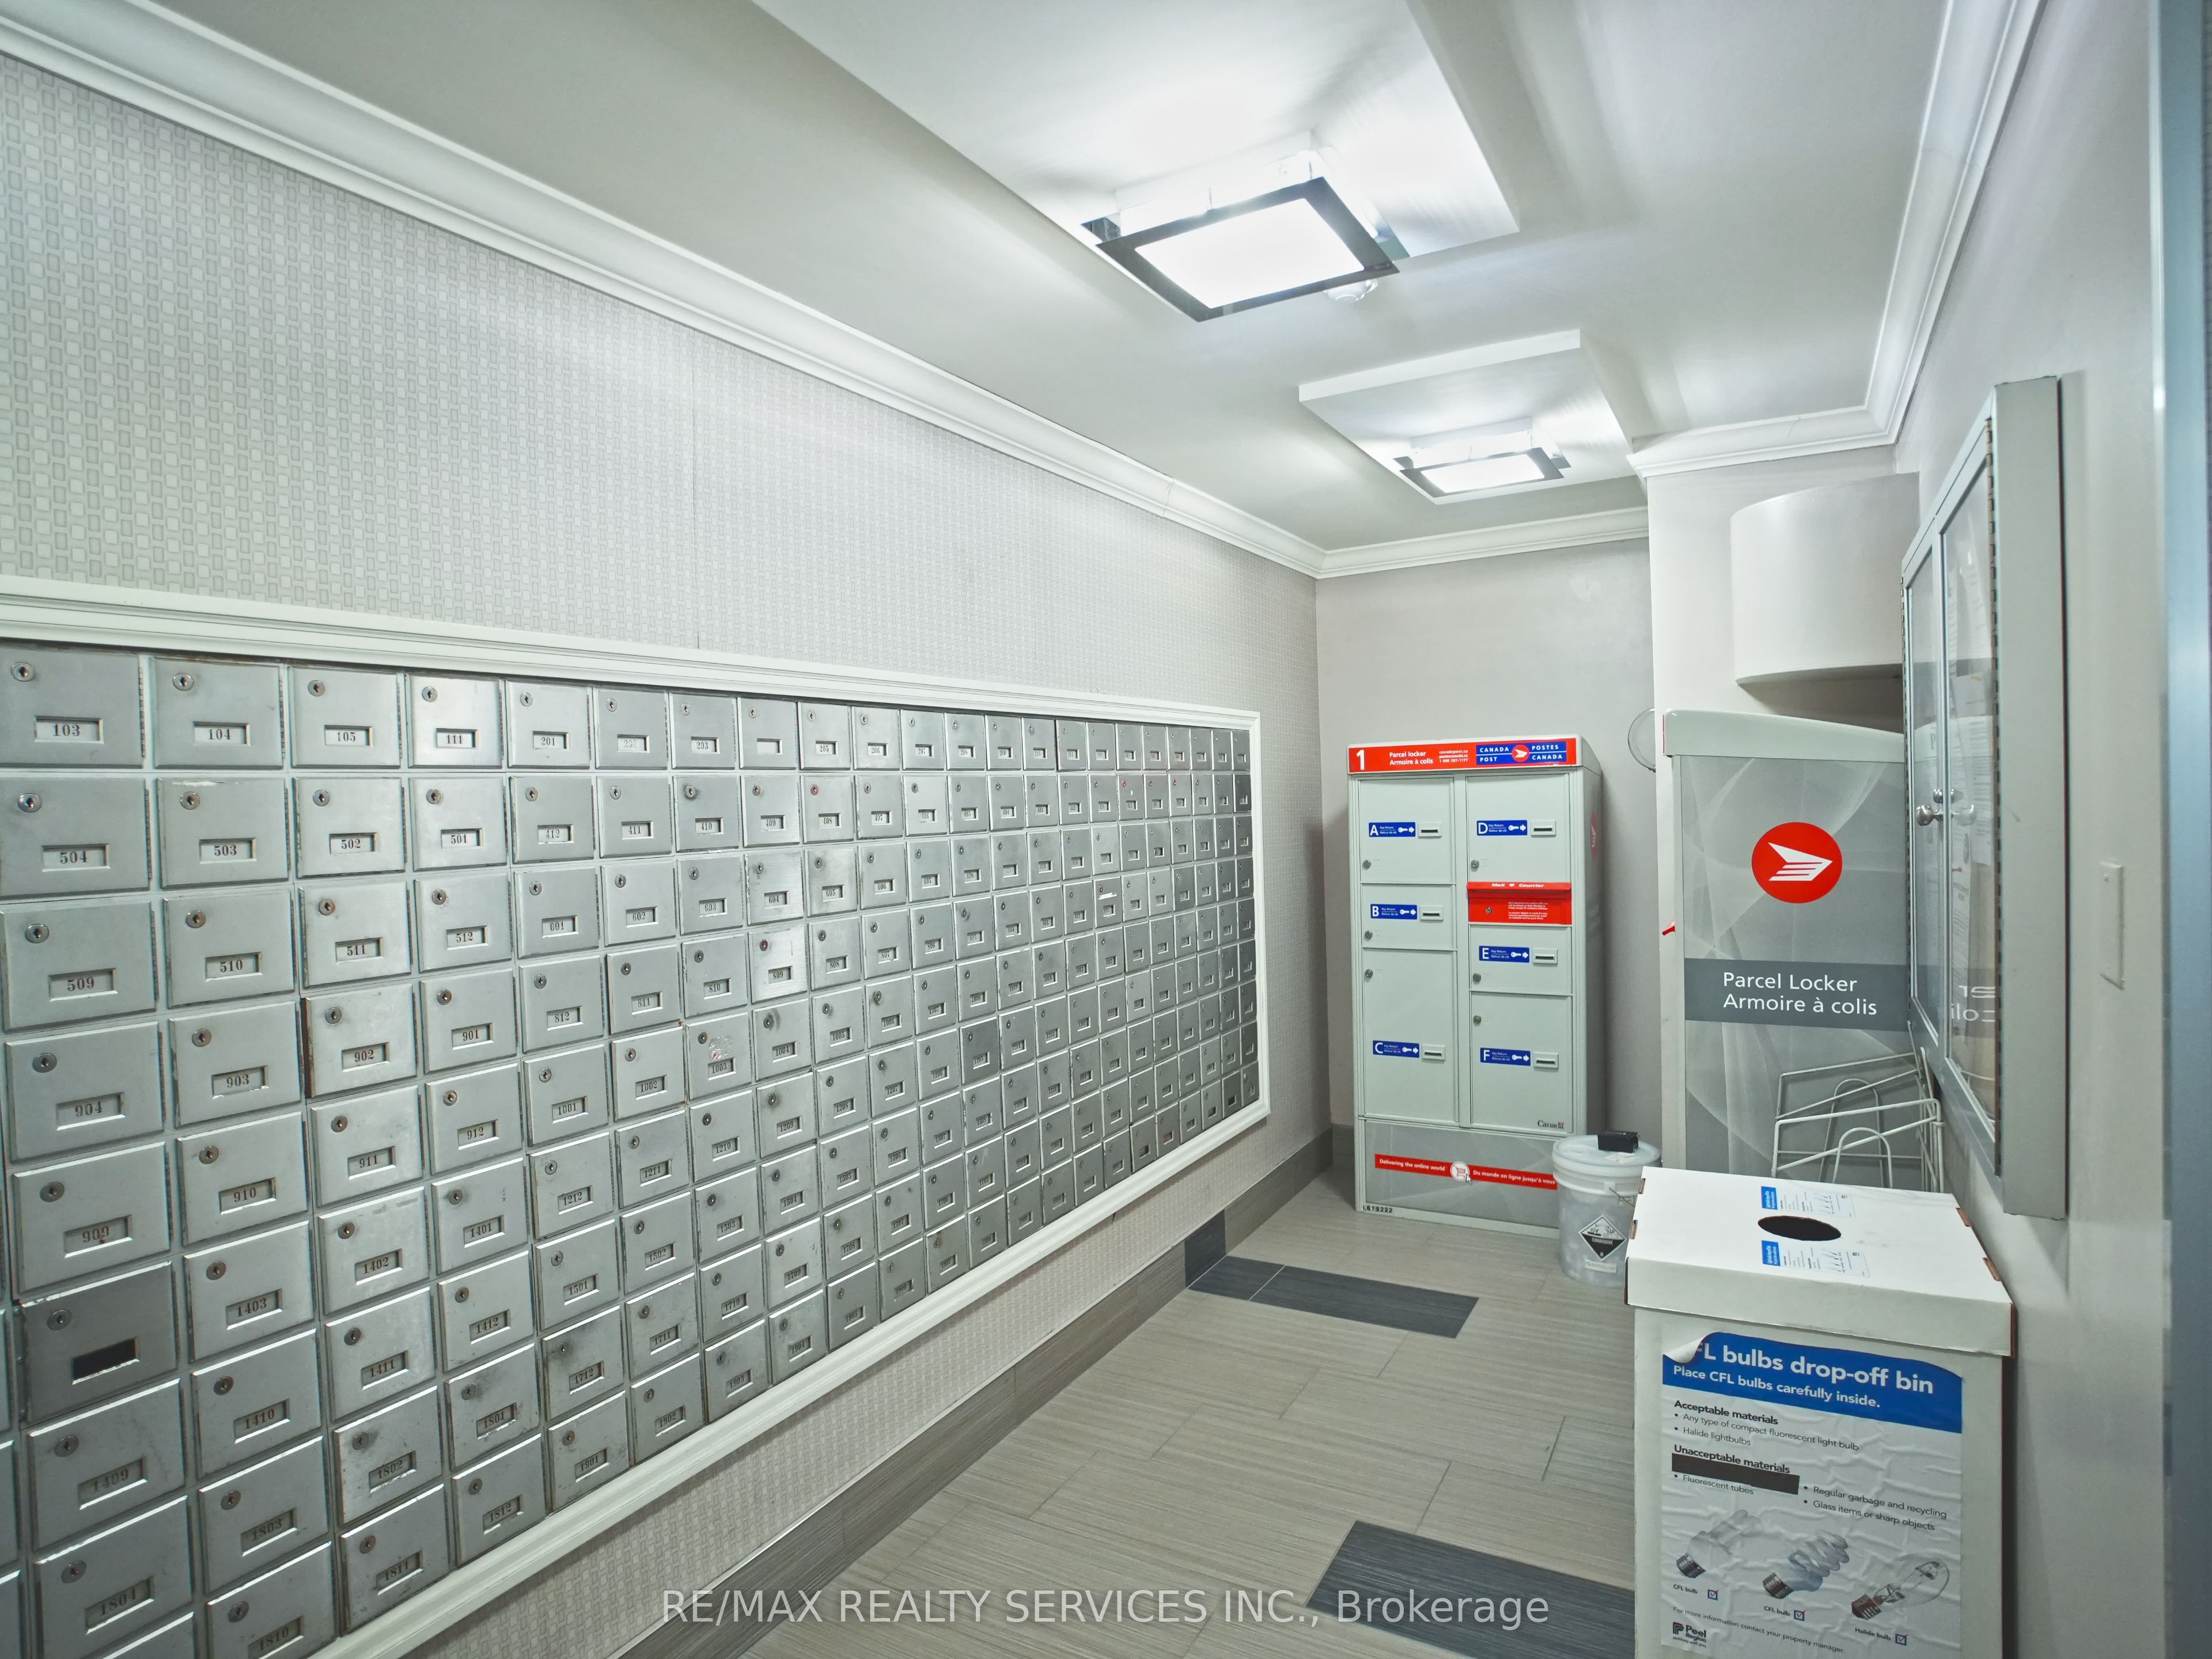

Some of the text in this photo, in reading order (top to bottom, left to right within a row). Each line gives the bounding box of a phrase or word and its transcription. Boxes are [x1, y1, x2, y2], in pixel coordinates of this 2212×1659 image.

[52, 724, 81, 737] 103
[208, 729, 231, 741] 104
[336, 732, 356, 743] 105
[446, 734, 463, 744] 111
[540, 737, 556, 746] 201
[696, 741, 709, 750] 203
[1356, 749, 1365, 770] 1
[628, 825, 642, 835] 411
[700, 822, 713, 831] 410
[1369, 824, 1379, 836] A
[1478, 822, 1488, 834] D
[450, 834, 468, 844] 501
[545, 830, 560, 839] 412
[214, 844, 237, 857] 503
[340, 838, 361, 850] 502
[59, 850, 88, 863] 504
[704, 903, 717, 912] 603
[1372, 906, 1380, 917] B
[632, 911, 646, 922] 602
[550, 921, 565, 931] 601
[456, 931, 474, 942] 512
[346, 944, 366, 956] 511
[1482, 947, 1490, 960] E
[219, 959, 244, 972] 510
[67, 976, 94, 991] 509
[1723, 971, 1858, 993] Parcel Locker
[637, 997, 652, 1008] 811
[1723, 994, 1877, 1016] Armoire à colis
[554, 1012, 570, 1023] 812
[462, 1030, 480, 1041] 901
[1374, 1041, 1384, 1054] C
[354, 1049, 375, 1062] 902
[1483, 1050, 1490, 1062] F
[711, 1062, 728, 1074] 1003
[226, 1074, 249, 1088] 903
[639, 1080, 658, 1093] 1002
[74, 1101, 103, 1118] 904
[557, 1102, 578, 1116] 1001
[779, 1121, 794, 1132] 1209
[1537, 1119, 1564, 1130] Canada
[467, 1127, 484, 1140] 912
[715, 1141, 732, 1154] 1210
[359, 1154, 378, 1168] 911
[1379, 1158, 1404, 1168] Delivering
[644, 1165, 662, 1179] 1211
[233, 1187, 257, 1202] 910
[562, 1192, 583, 1206] 1212
[82, 1226, 110, 1243] 909
[469, 1222, 493, 1238] 1401
[1592, 1237, 1613, 1245] CORROSIVE
[362, 1257, 389, 1274] 1402
[569, 1281, 589, 1296] 1501
[235, 1297, 267, 1318] 1403
[475, 1317, 499, 1335] 1412
[369, 1359, 396, 1377] 1411
[1723, 1345, 1783, 1370] bulbs
[1790, 1356, 1889, 1387] drop-off
[1896, 1370, 1933, 1394] bin
[575, 1368, 595, 1384] 1712
[1673, 1365, 1880, 1408] Place CFL bulbs carefully inside.
[244, 1408, 275, 1430] 1410
[1674, 1400, 1779, 1425] Acceptable materials
[483, 1411, 506, 1429] 1801
[1683, 1414, 1699, 1423] Any
[1701, 1417, 1718, 1427] type
[1731, 1423, 1767, 1434] compact
[1769, 1427, 1816, 1444] fluorescent
[1817, 1437, 1837, 1448] light
[1839, 1440, 1859, 1451] bulb
[1683, 1426, 1751, 1446] Halide lightbulbs
[579, 1455, 599, 1472] 1901
[1673, 1444, 1790, 1474] Unacceptable materials
[376, 1460, 403, 1479] 1802
[92, 1467, 129, 1492] 1409
[1683, 1474, 1754, 1495] Fluorescent tubes
[1813, 1486, 1947, 1520] Regular garbage and recycling
[489, 1502, 512, 1522] 1812
[1813, 1500, 1936, 1531] Glass items or sharp objects
[251, 1517, 282, 1541] 1803
[384, 1560, 410, 1581] 1811
[1685, 1586, 1698, 1594] bulb
[100, 1587, 137, 1616] 1804
[1763, 1605, 1790, 1617] CFL bulb
[1673, 1605, 1684, 1614] For
[1703, 1613, 1740, 1627] information
[1740, 1623, 1766, 1634] contact
[1766, 1630, 1782, 1638] your
[1782, 1634, 1812, 1646] property
[1813, 1641, 1845, 1654] manager.
[1685, 1624, 1707, 1638] Peel
[1854, 1626, 1892, 1641] Halide bulb
[1685, 1632, 1707, 1643] Region
